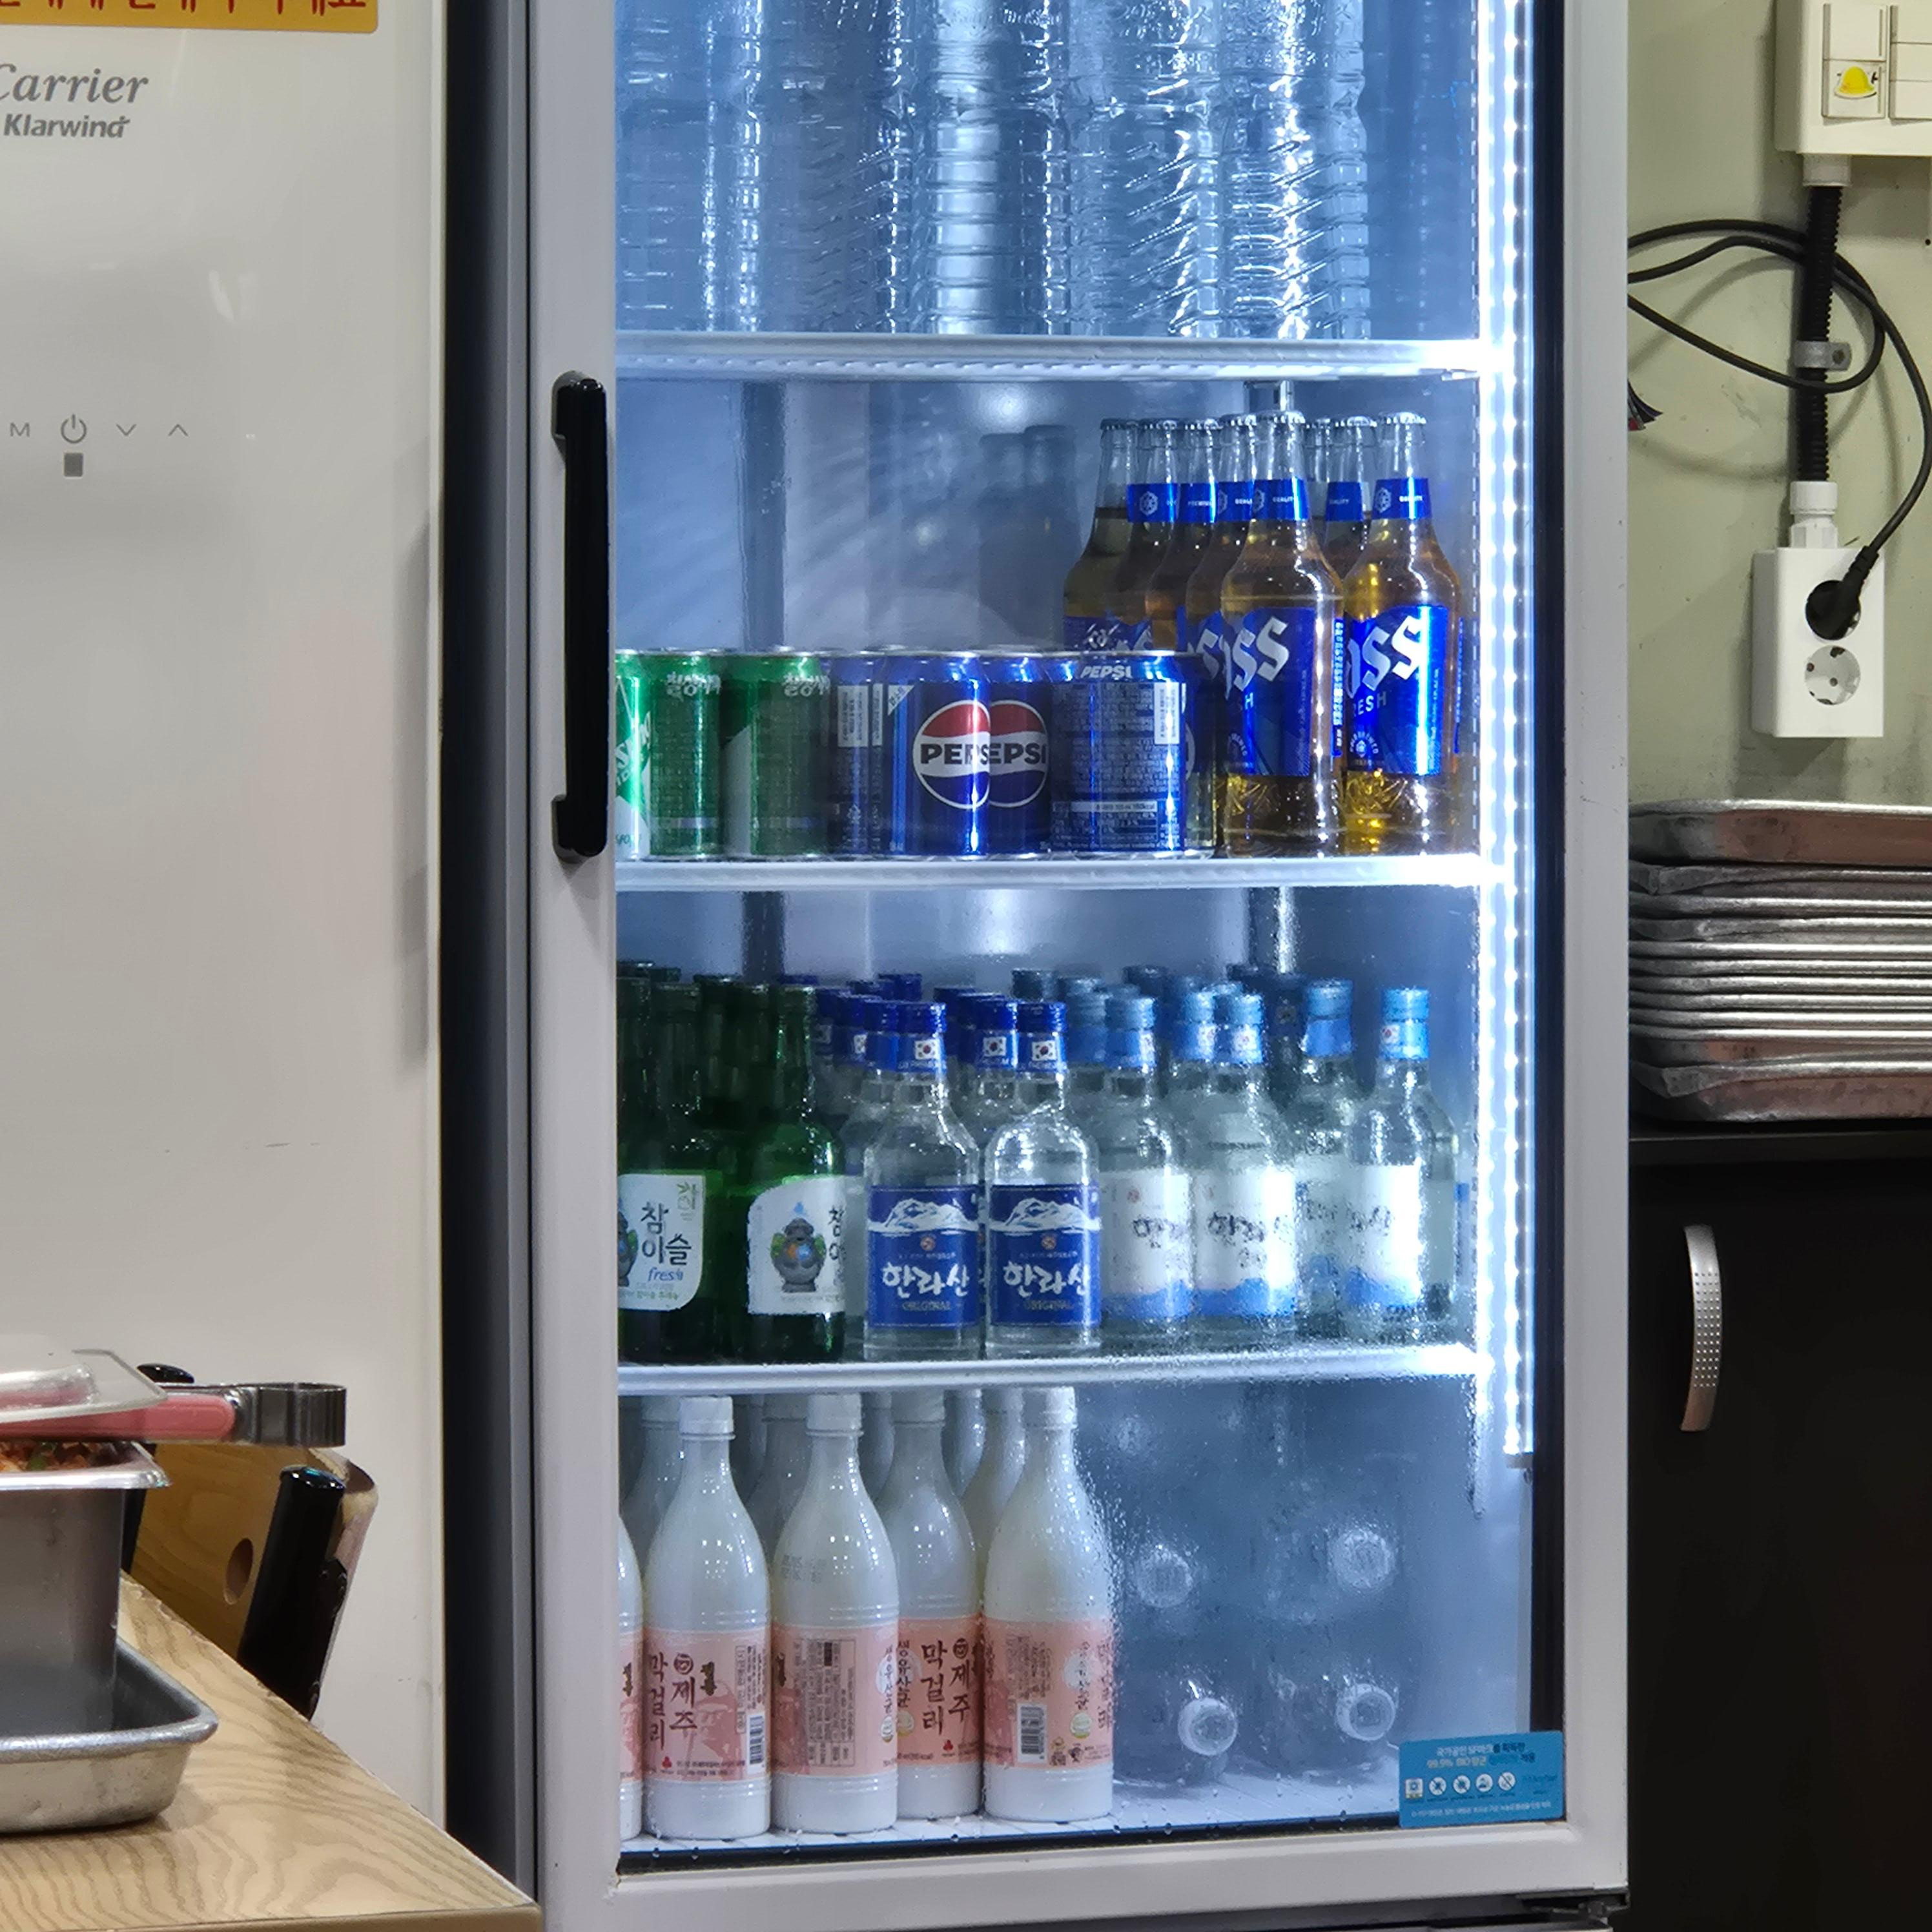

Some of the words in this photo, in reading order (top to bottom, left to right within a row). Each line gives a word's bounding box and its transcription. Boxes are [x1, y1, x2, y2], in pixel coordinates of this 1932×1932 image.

[3, 113, 130, 138] Klarwind
[1079, 664, 1133, 679] PEPSI
[920, 743, 990, 765] PEPS
[989, 743, 1047, 765] EPSI
[882, 1261, 970, 1299] 한라산
[1003, 1260, 1089, 1298] 한라산
[650, 1651, 668, 1751] 막걸리
[669, 1676, 697, 1731] 제주
[921, 1640, 947, 1736] 막걸리
[949, 1659, 971, 1723] 제주
